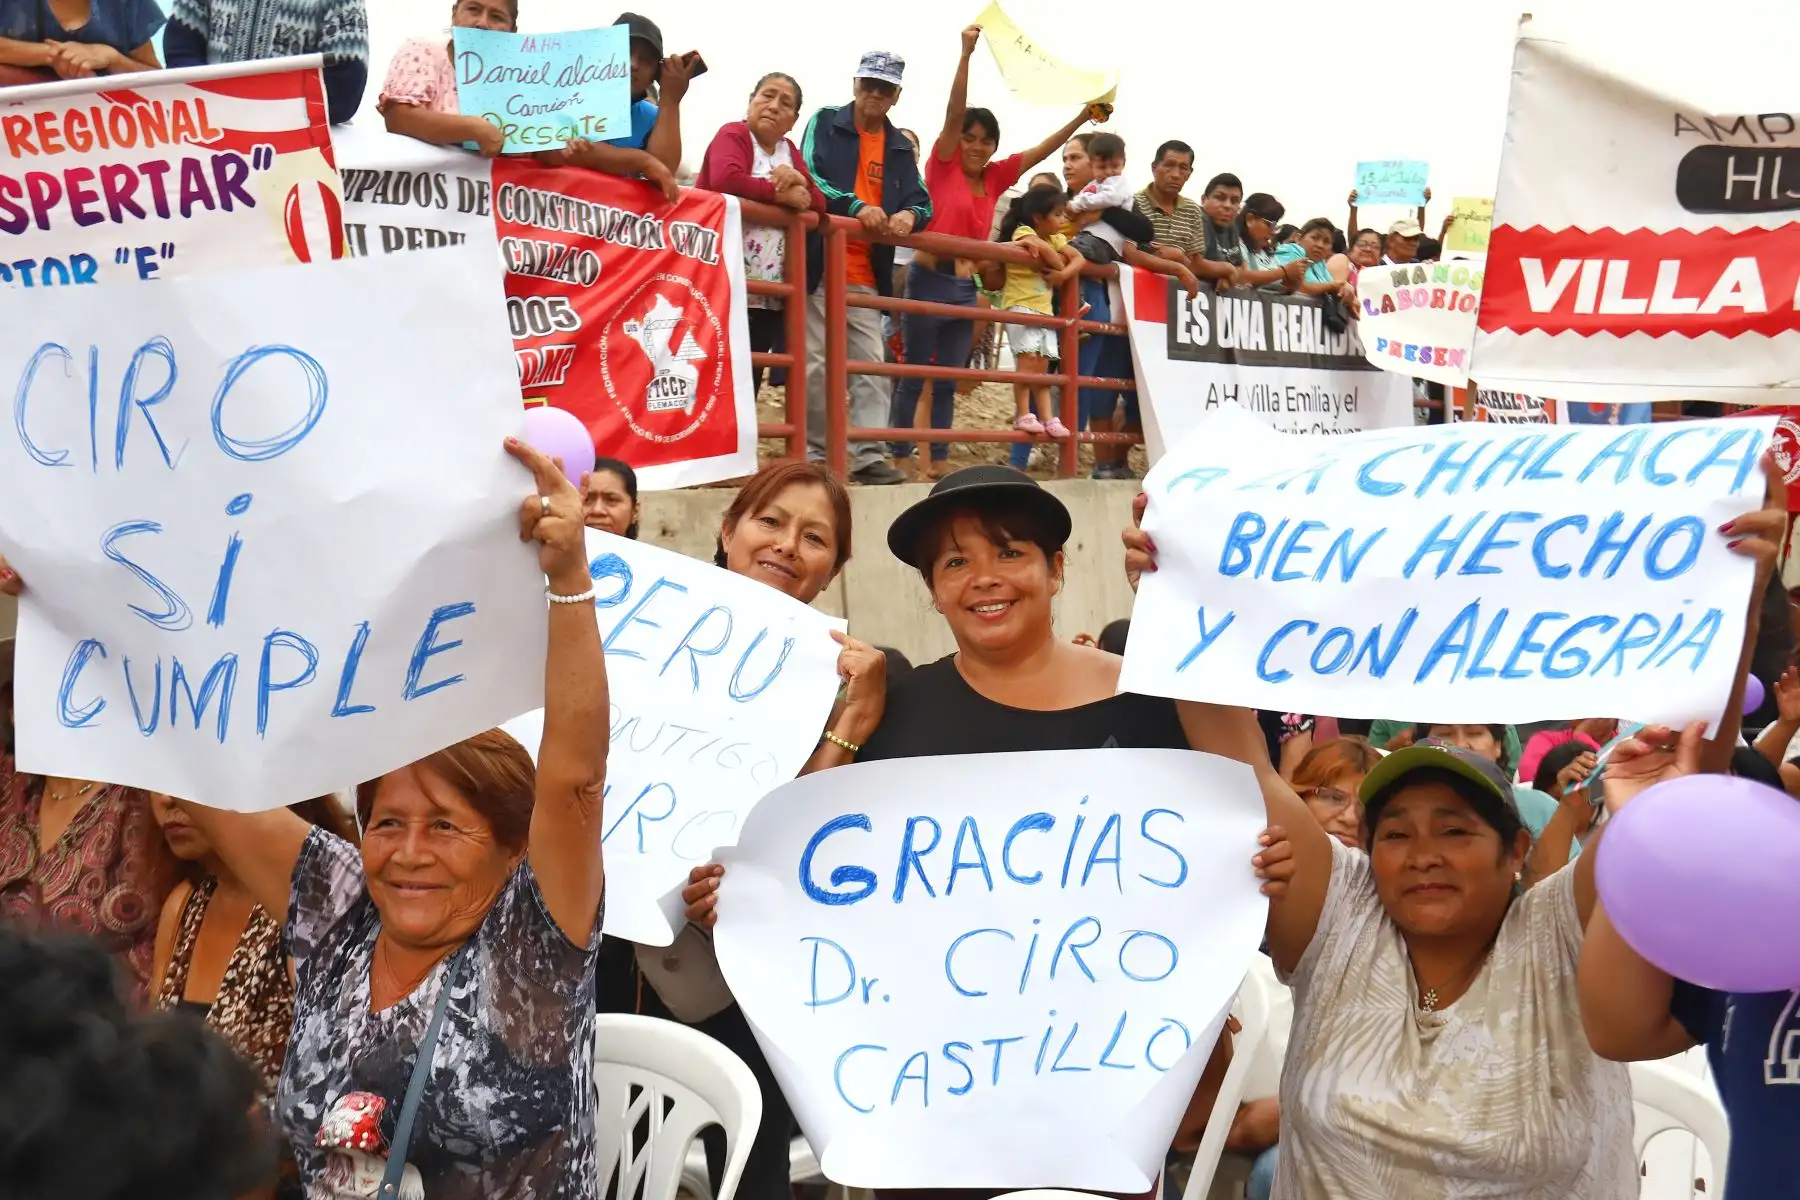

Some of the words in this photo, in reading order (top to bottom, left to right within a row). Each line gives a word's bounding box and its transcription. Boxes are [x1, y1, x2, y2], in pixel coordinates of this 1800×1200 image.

[458, 51, 550, 85] Daniel
[1, 98, 223, 159] REGIONAL
[1674, 112, 1796, 143] AMP
[456, 177, 491, 217] DE
[498, 184, 667, 250] CONSTRUCCIÓN
[669, 221, 719, 265] CIVIL
[499, 236, 602, 288] CALLAO
[1390, 265, 1483, 291] MANOS
[1518, 257, 1768, 315] VILLA
[1176, 289, 1211, 346] ES
[1216, 295, 1268, 352] UNA
[1363, 288, 1478, 316] LABORIO
[14, 335, 328, 472] CIRO
[1245, 384, 1280, 413] Villa
[1285, 386, 1330, 413] Emilia
[1332, 393, 1342, 419] y
[1344, 386, 1358, 413] el
[1355, 427, 1763, 499] CHALACA
[1218, 510, 1388, 583] BIEN
[1402, 510, 1706, 580] HECHO
[57, 601, 476, 744] CUMPLE
[1175, 604, 1236, 674] Y
[1256, 603, 1420, 684] CON
[800, 936, 891, 1014] Dr.
